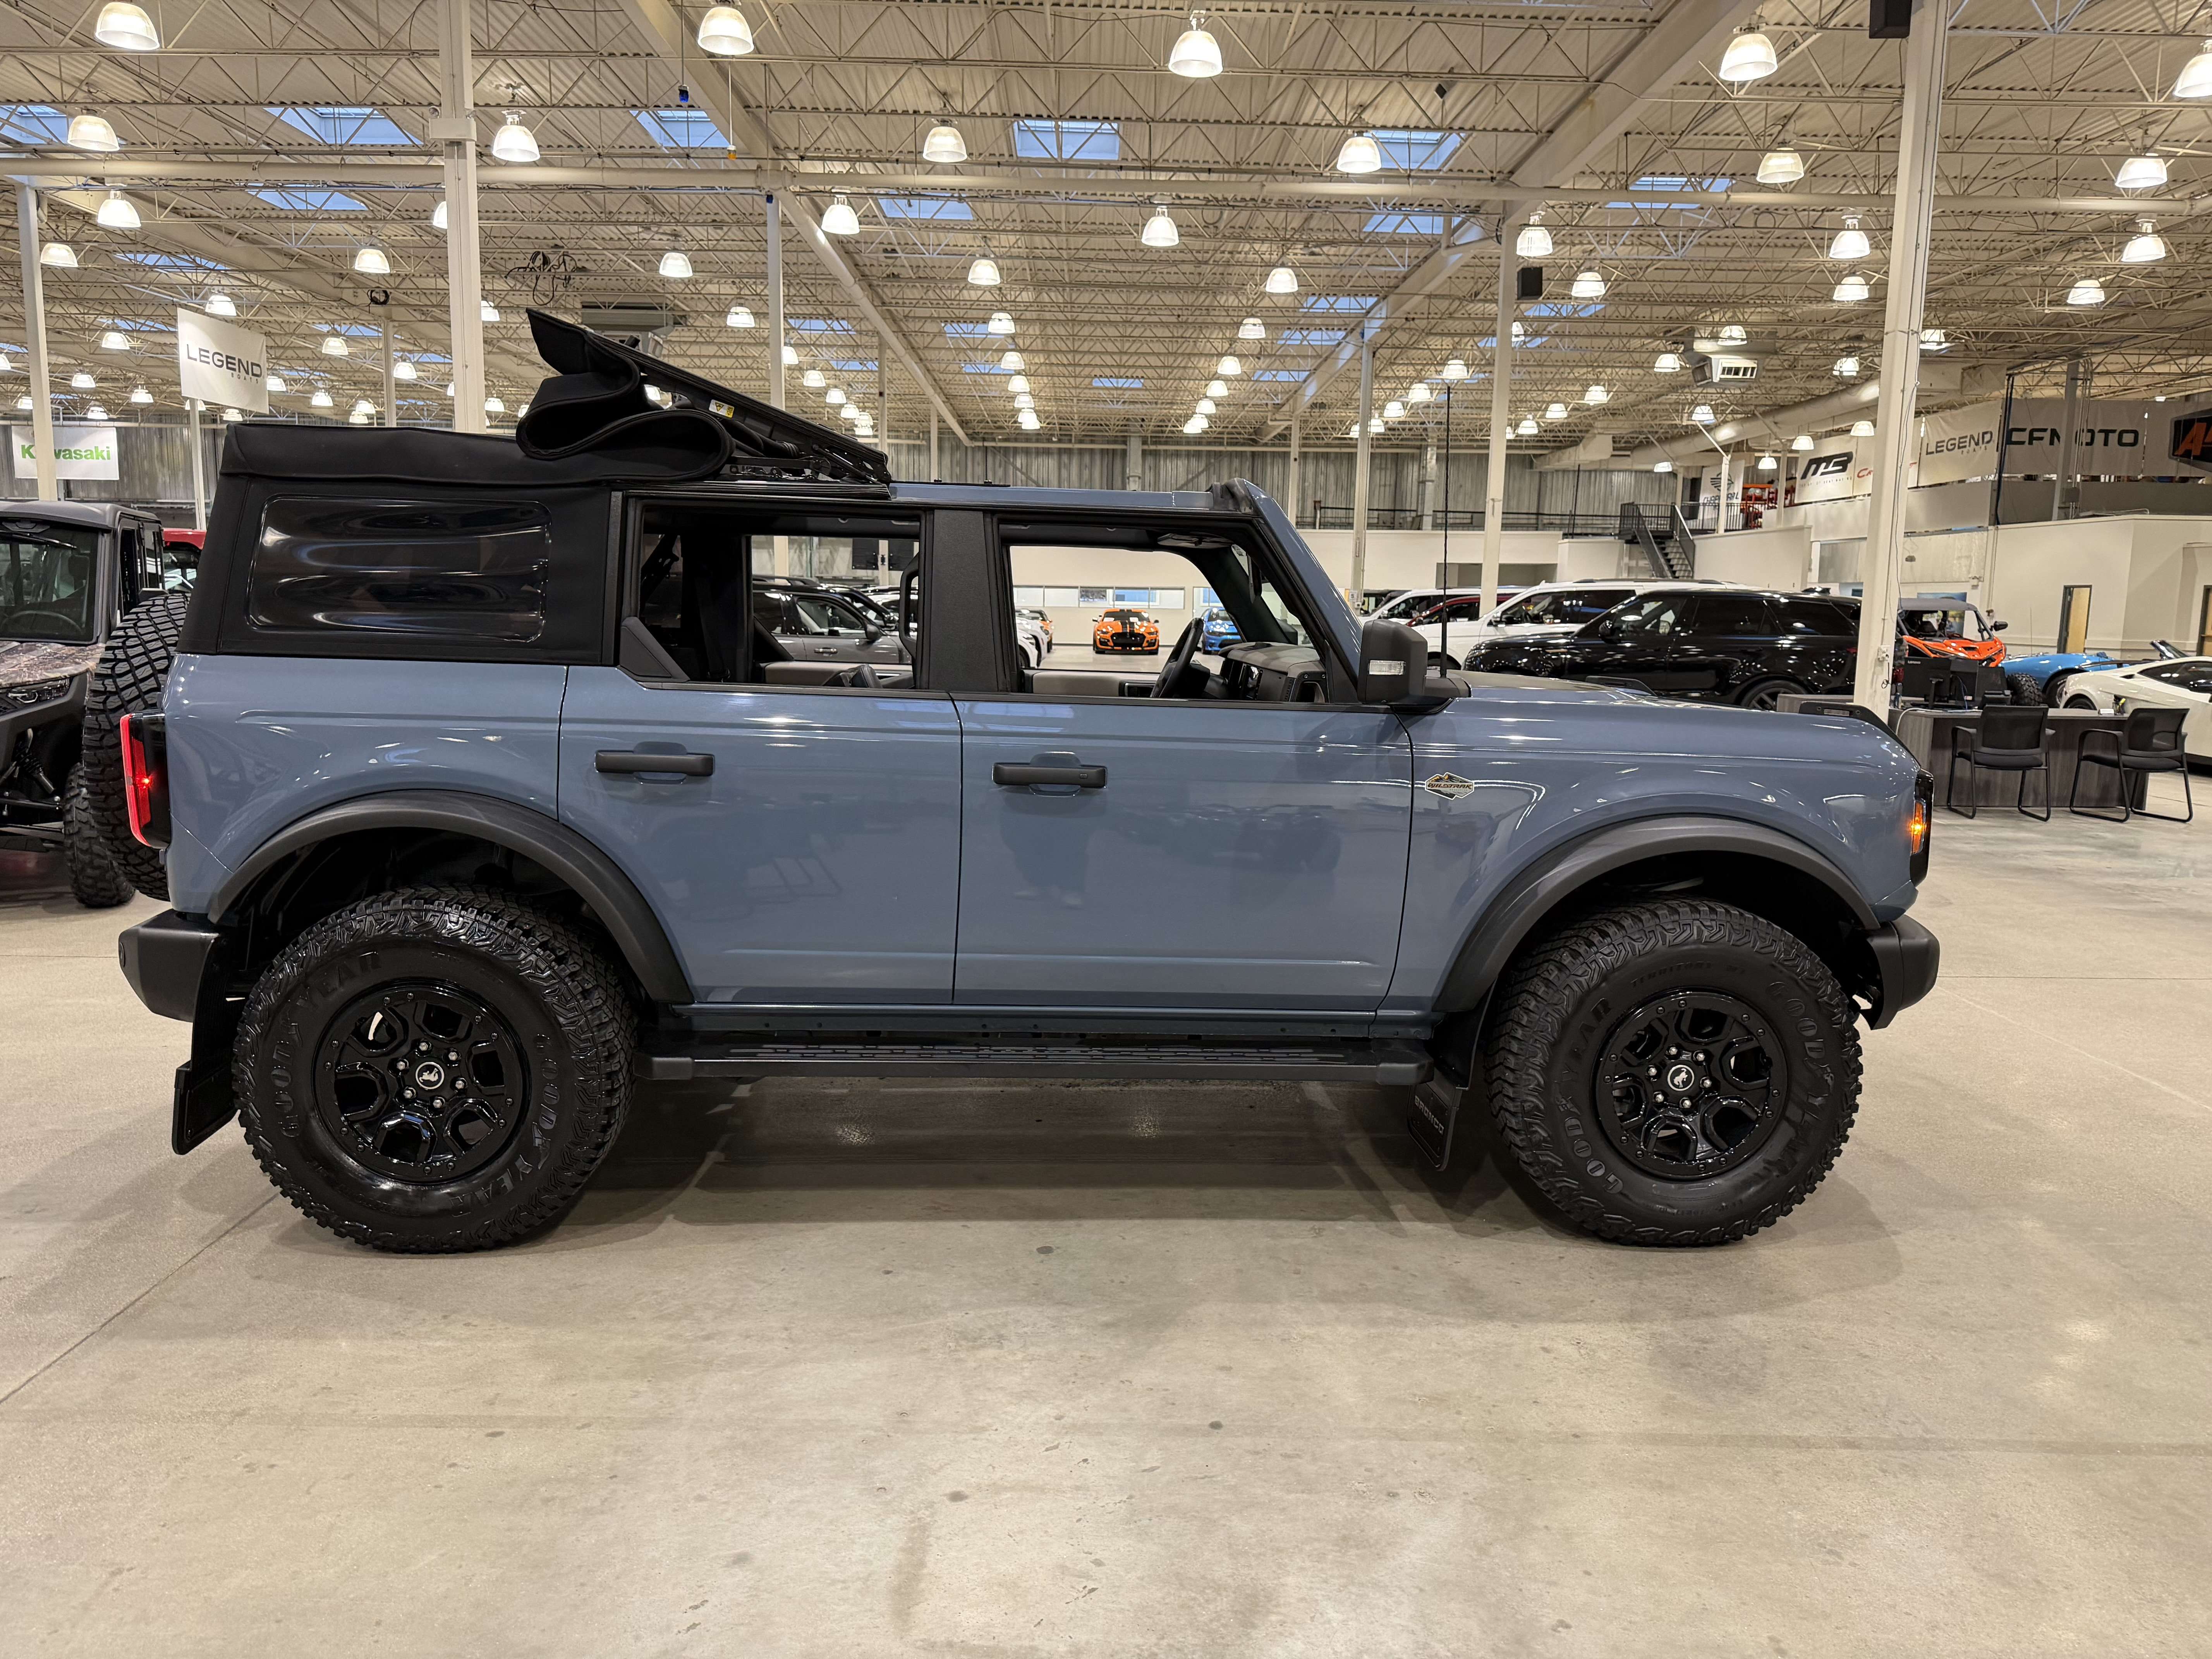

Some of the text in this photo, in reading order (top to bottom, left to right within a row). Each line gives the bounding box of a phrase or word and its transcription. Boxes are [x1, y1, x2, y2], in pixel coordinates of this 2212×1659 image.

[187, 344, 262, 378] LEGEND
[231, 372, 258, 384] BOATS
[21, 445, 111, 460] Kwasaki
[1926, 431, 1993, 455] LEGEND
[1415, 1095, 1444, 1135] BRONCO
